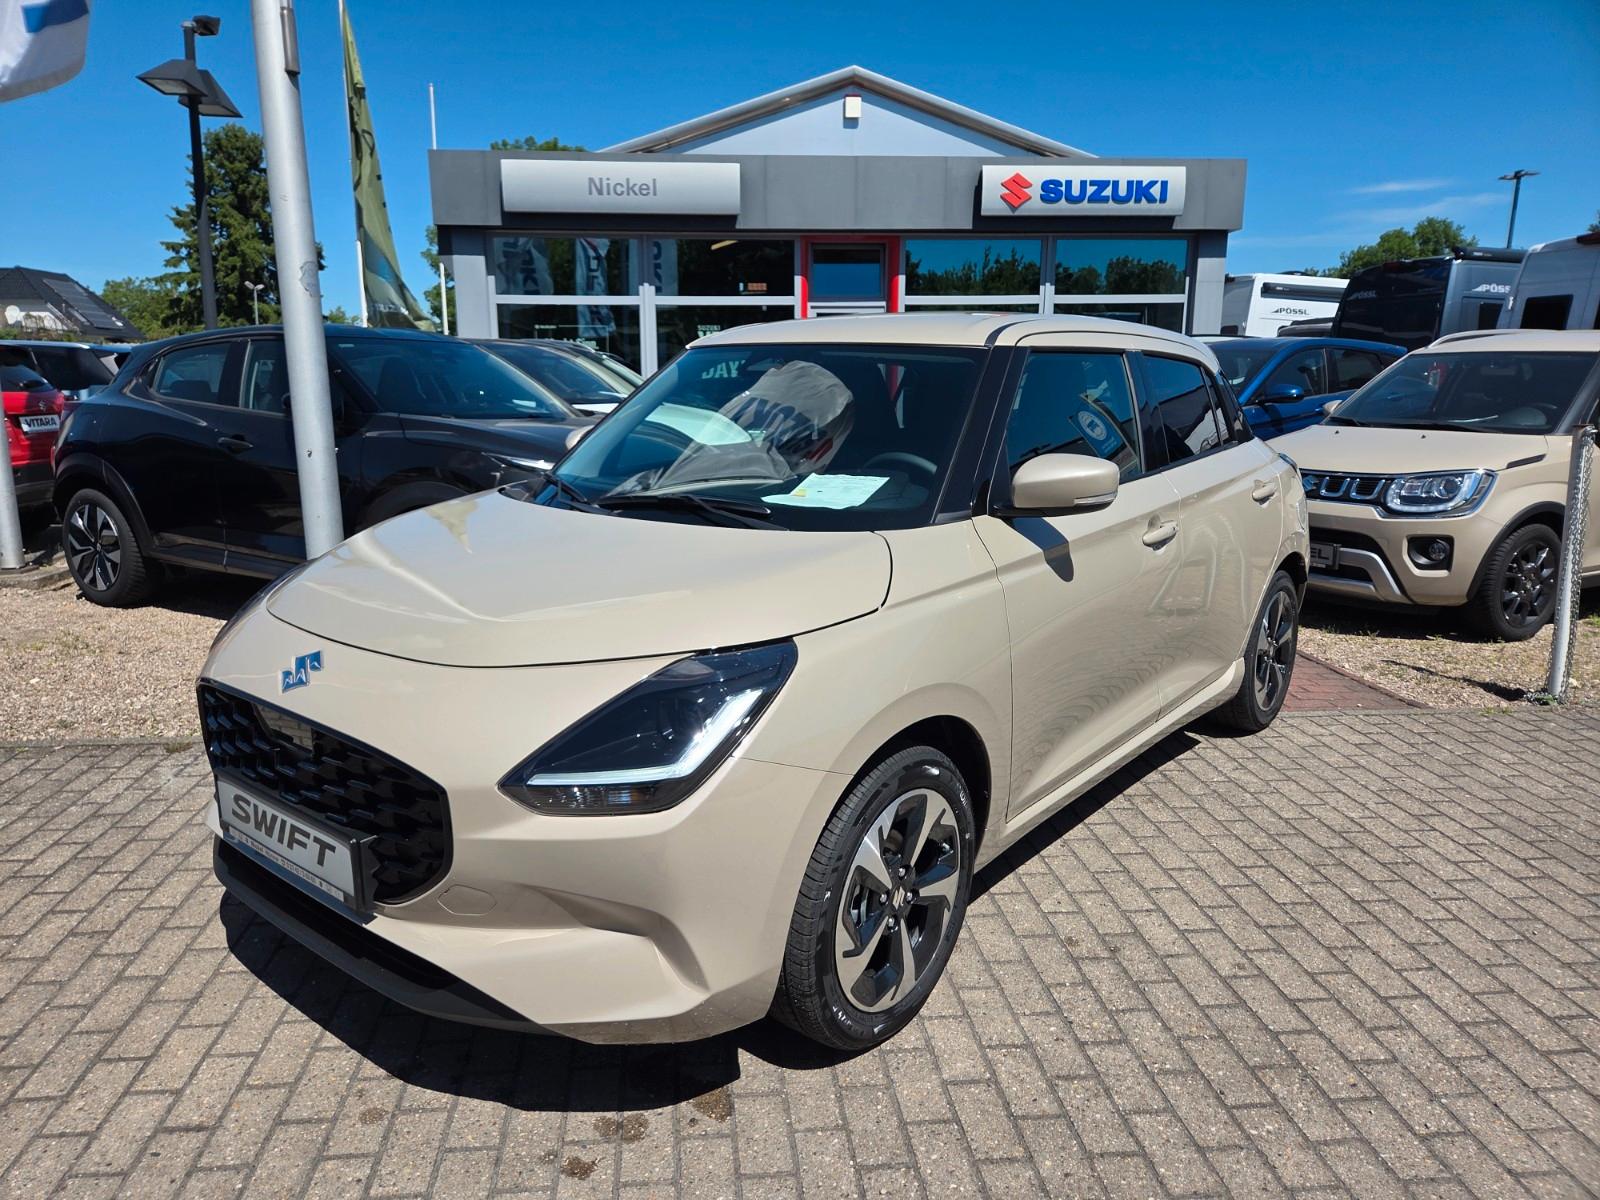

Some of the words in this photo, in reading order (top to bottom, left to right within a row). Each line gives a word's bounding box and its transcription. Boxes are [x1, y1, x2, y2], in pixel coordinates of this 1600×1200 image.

[587, 177, 657, 196] Nickel
[1039, 179, 1169, 205] SUZUKI
[1481, 283, 1511, 294] PÖSS
[1279, 306, 1310, 316] PÖSSL
[25, 417, 57, 428] VITARA
[231, 793, 337, 867] SWIFT
